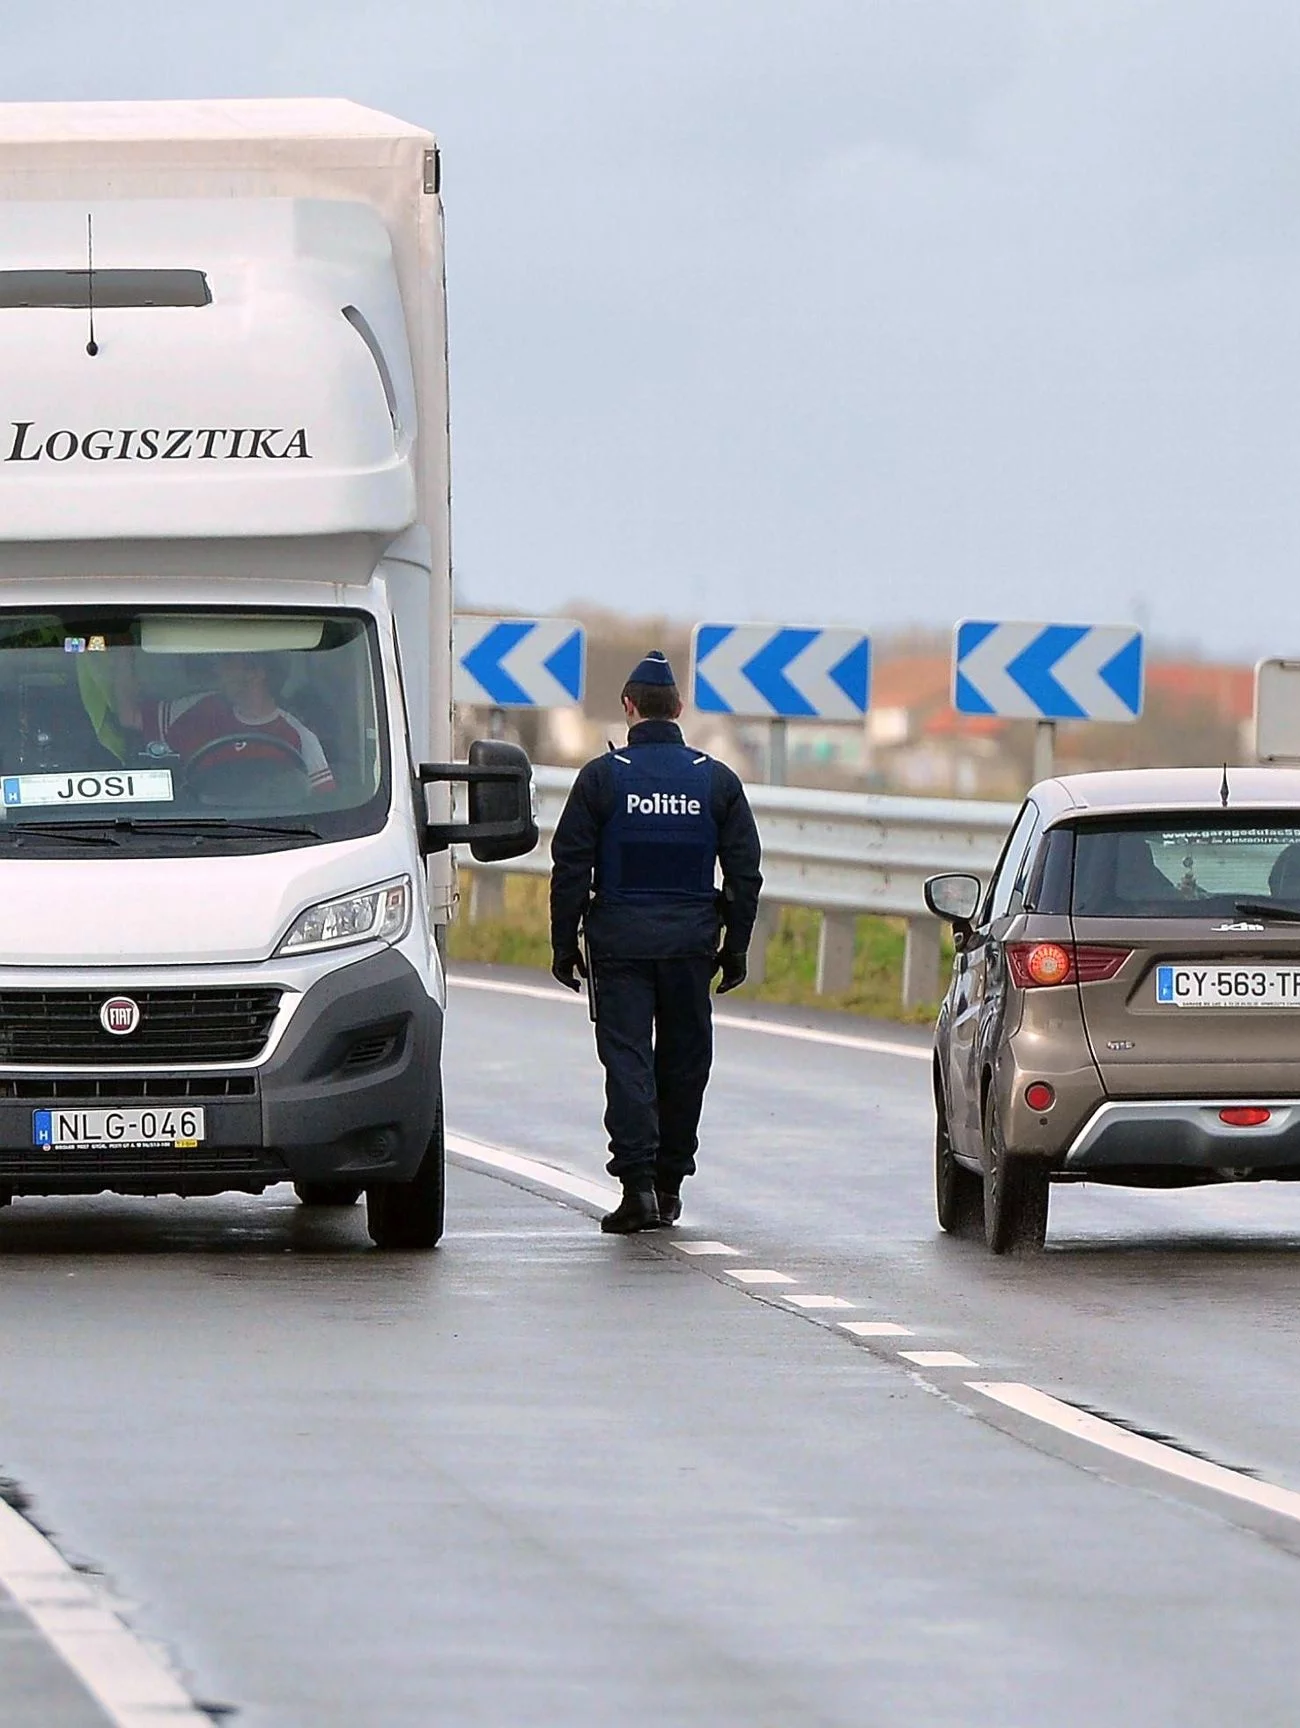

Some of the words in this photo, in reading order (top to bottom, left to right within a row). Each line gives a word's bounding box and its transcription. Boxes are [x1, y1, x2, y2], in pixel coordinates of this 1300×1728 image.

[4, 422, 313, 461] LOGISZTIKA
[57, 776, 134, 799] JOSI
[627, 793, 701, 815] Politie
[110, 1008, 132, 1026] FIAT
[39, 1130, 48, 1141] H
[59, 1111, 196, 1141] NLG-046
